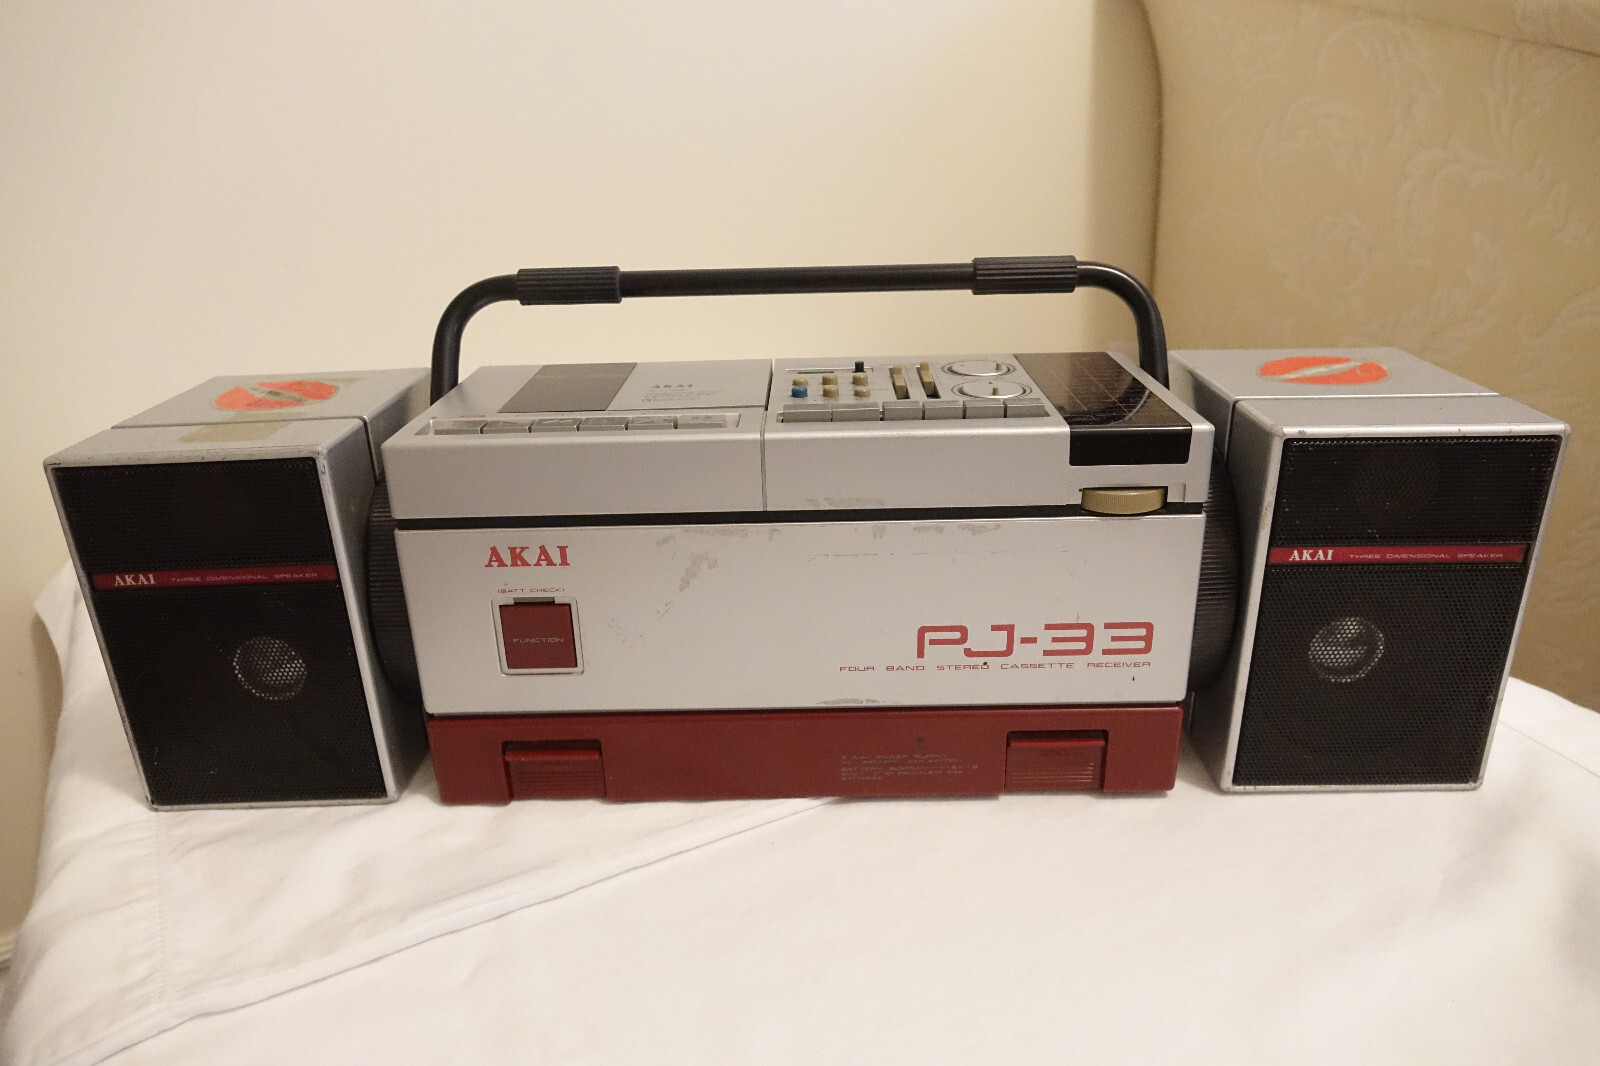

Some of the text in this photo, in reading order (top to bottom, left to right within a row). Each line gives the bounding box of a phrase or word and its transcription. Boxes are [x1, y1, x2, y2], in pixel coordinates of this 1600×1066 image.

[485, 544, 571, 568] AKAI
[1289, 549, 1334, 561] AKAI
[114, 571, 318, 587] AKAI THREE DIMENSIONAL SPEAKER
[916, 621, 1155, 659] PJ-33
[885, 664, 925, 672] BAND
[936, 663, 990, 671] STEREO
[1000, 661, 1075, 670] CASSETTE
[1086, 660, 1151, 669] RECEIVER
